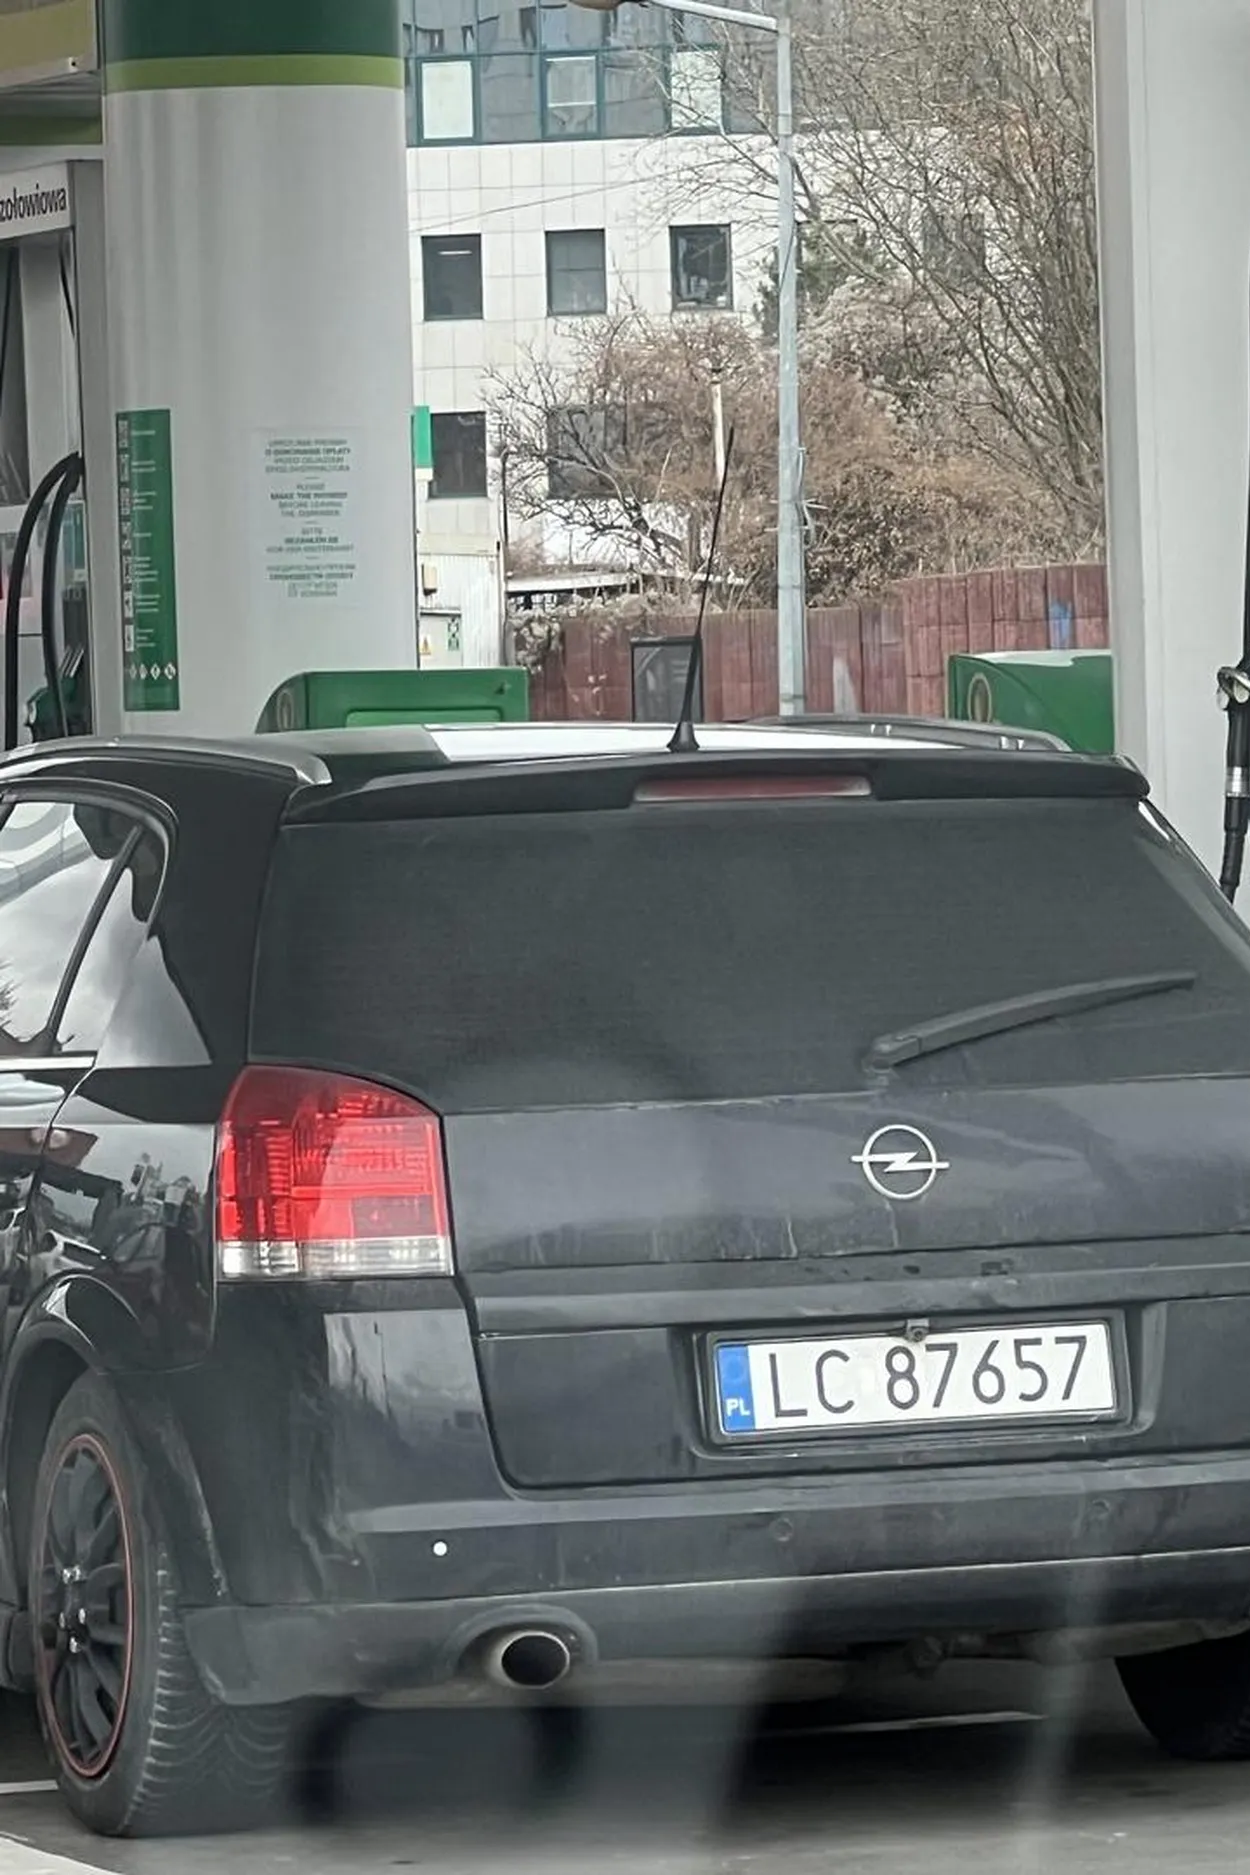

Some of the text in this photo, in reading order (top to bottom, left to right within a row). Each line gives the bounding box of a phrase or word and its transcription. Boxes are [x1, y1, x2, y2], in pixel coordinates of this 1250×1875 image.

[770, 1335, 1087, 1418] LC 87657
[726, 1398, 751, 1417] PL
